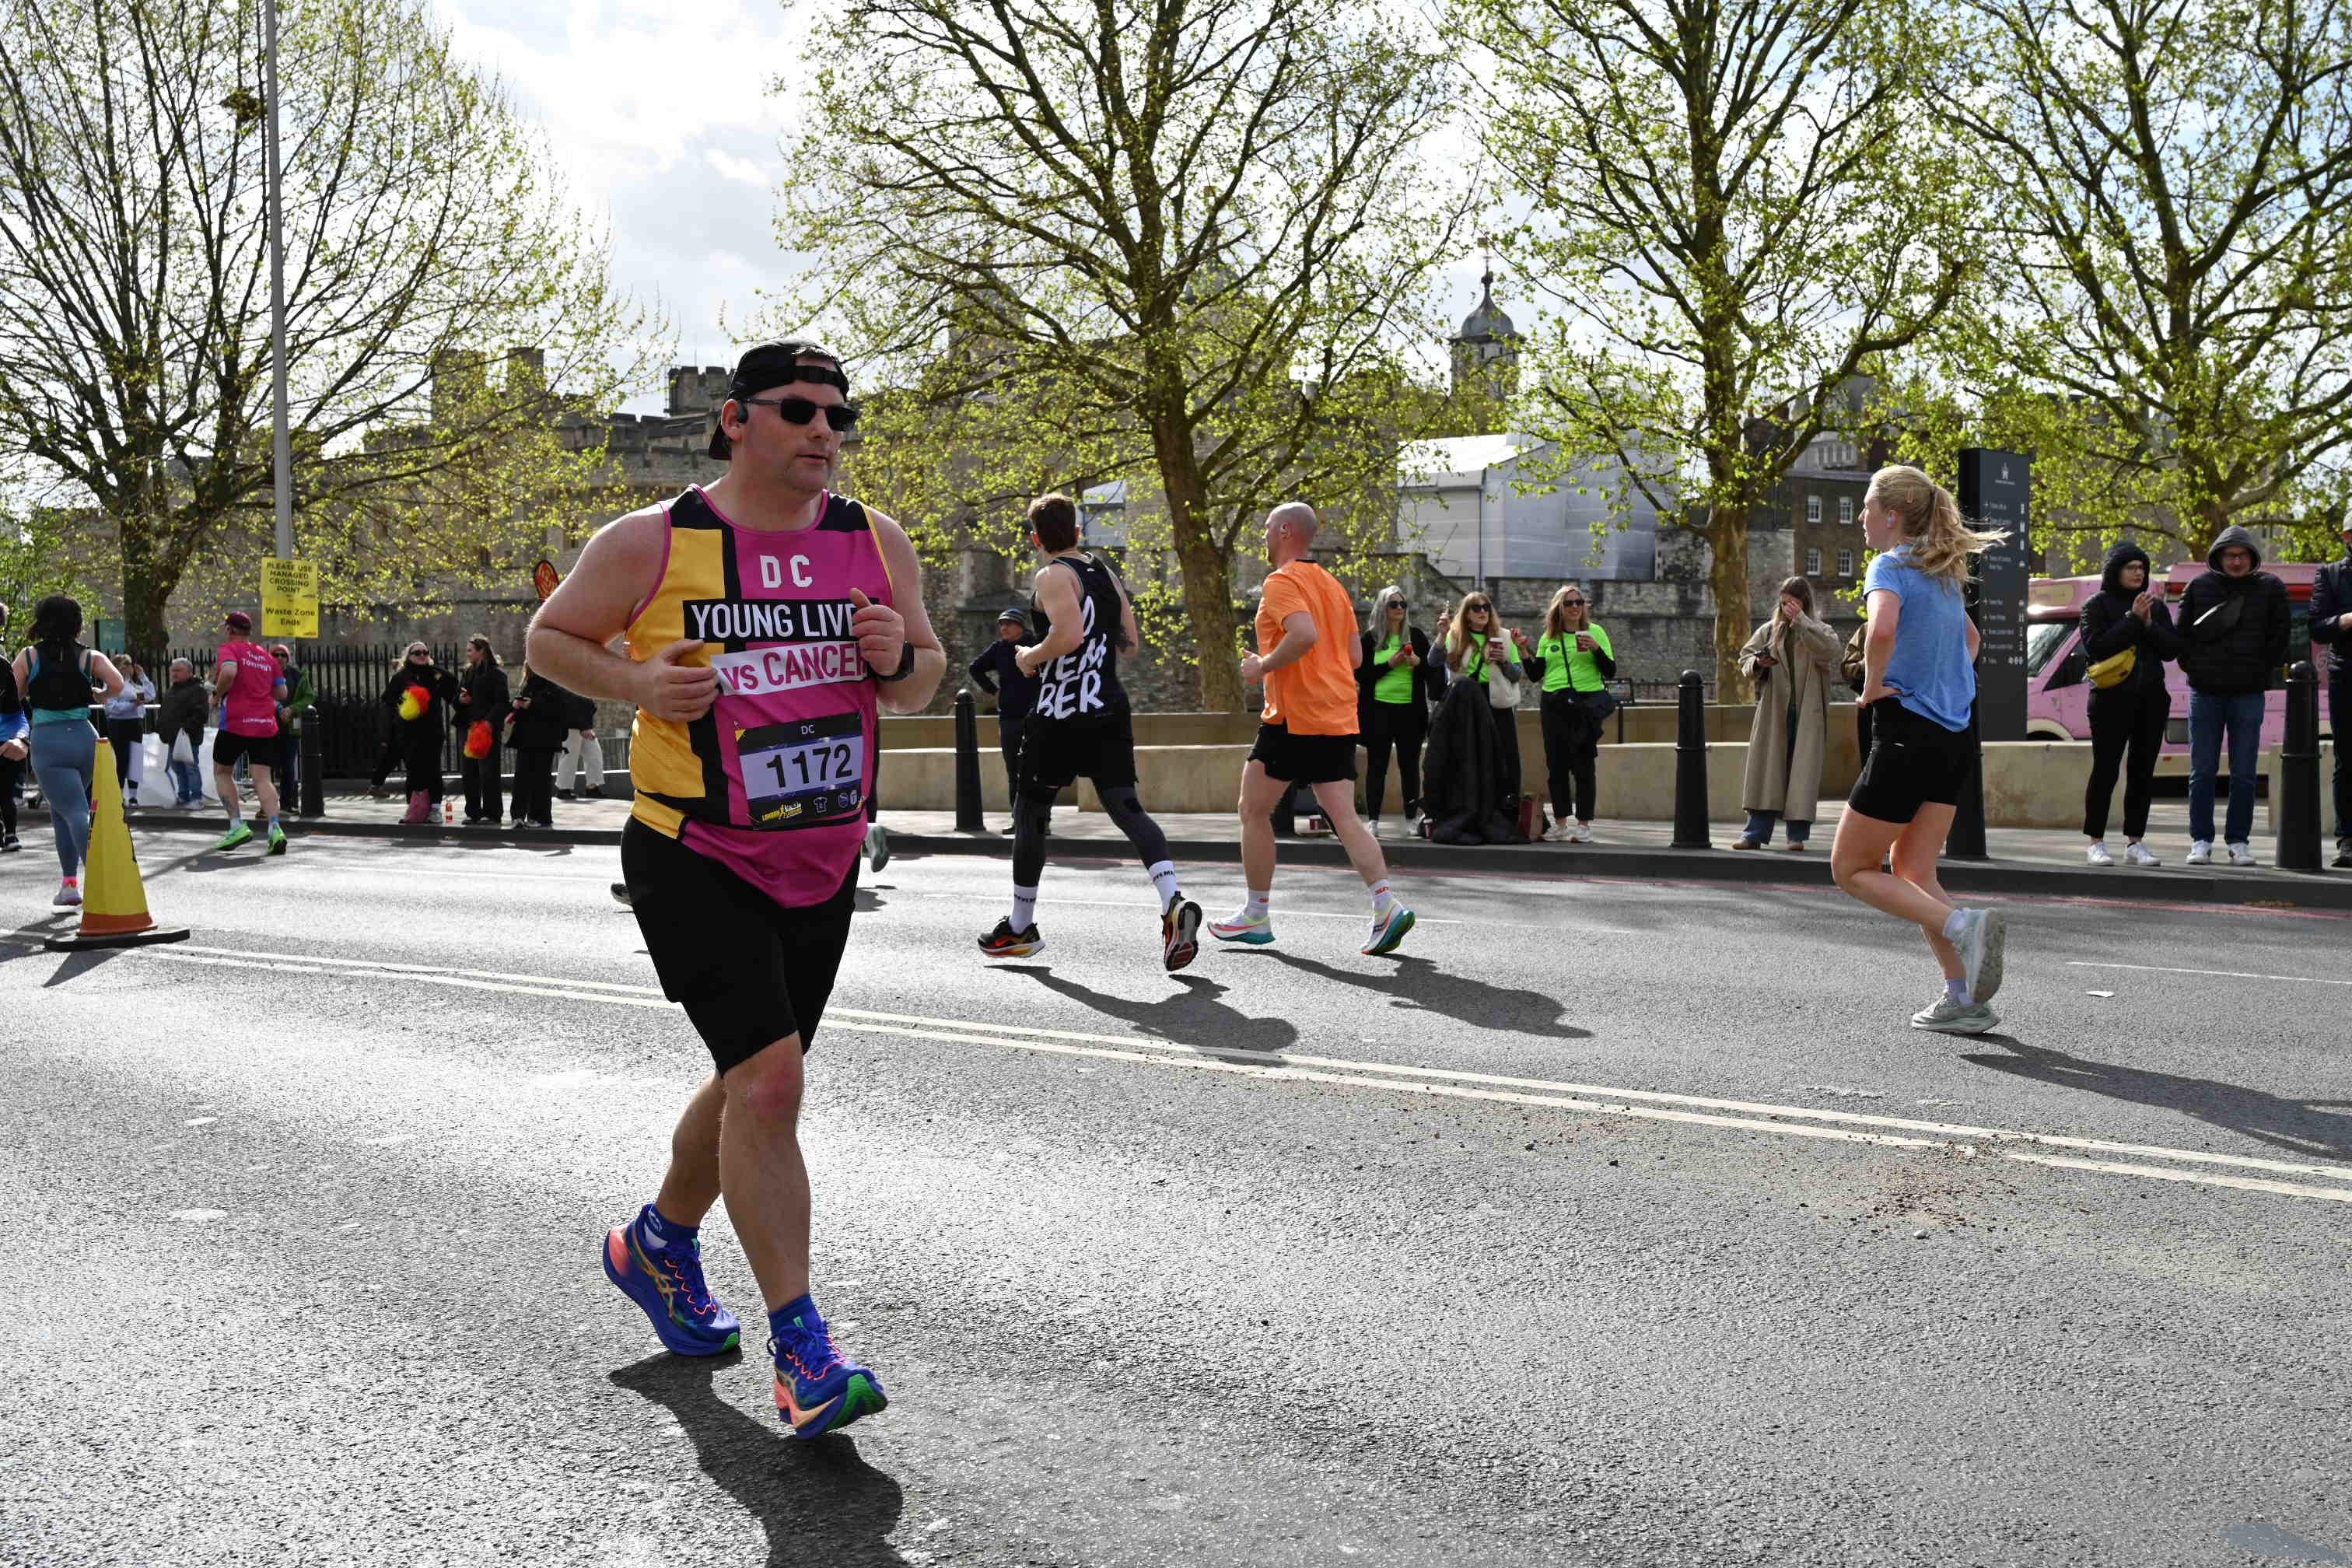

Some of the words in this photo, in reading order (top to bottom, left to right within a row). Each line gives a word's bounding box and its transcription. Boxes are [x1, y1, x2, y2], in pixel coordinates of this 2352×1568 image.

[269, 578, 310, 587] CROSSING
[270, 571, 310, 579] MANAGED
[691, 604, 792, 639] YOUNG
[801, 603, 857, 637] LIVE
[1037, 669, 1105, 719] BER
[801, 724, 816, 735] DC
[766, 744, 853, 789] 1172
